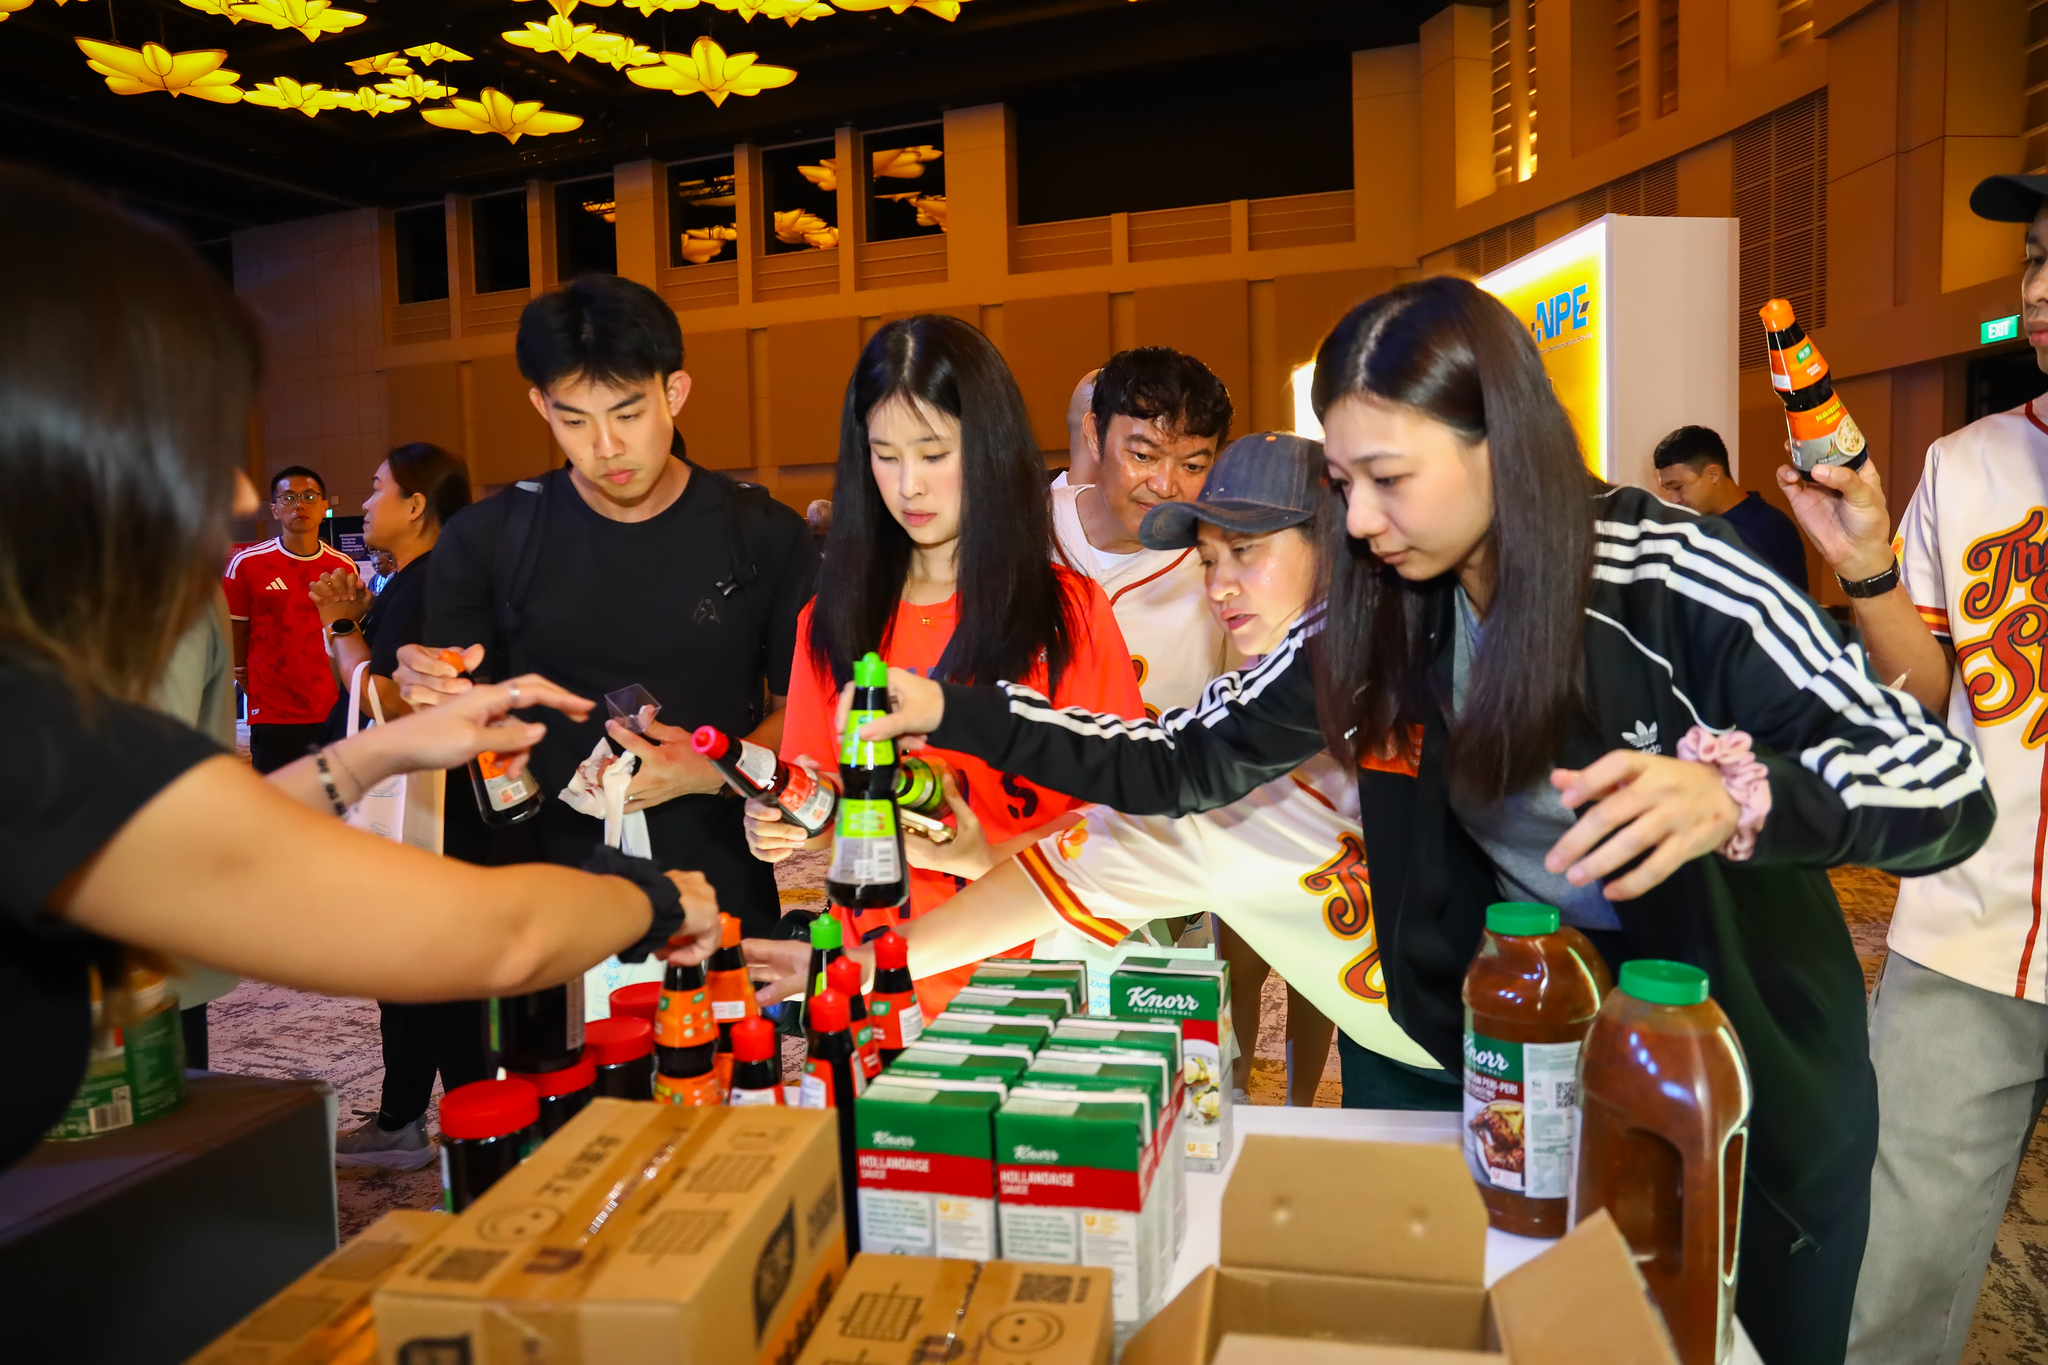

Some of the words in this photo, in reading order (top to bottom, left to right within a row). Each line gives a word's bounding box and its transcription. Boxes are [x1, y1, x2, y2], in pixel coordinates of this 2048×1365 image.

[1535, 283, 1588, 343] NPE
[1988, 320, 2011, 339] EXIT
[1126, 985, 1199, 1011] Knorr
[1133, 1006, 1192, 1017] PROFESSIONAL
[872, 1130, 916, 1147] Knorr
[1013, 1144, 1060, 1161] Knorr
[859, 1154, 931, 1173] HOLLANDAISE
[860, 1168, 887, 1180] SAUCE
[999, 1169, 1076, 1187] HOLLANDAISE
[1000, 1184, 1029, 1195] SAUCE
